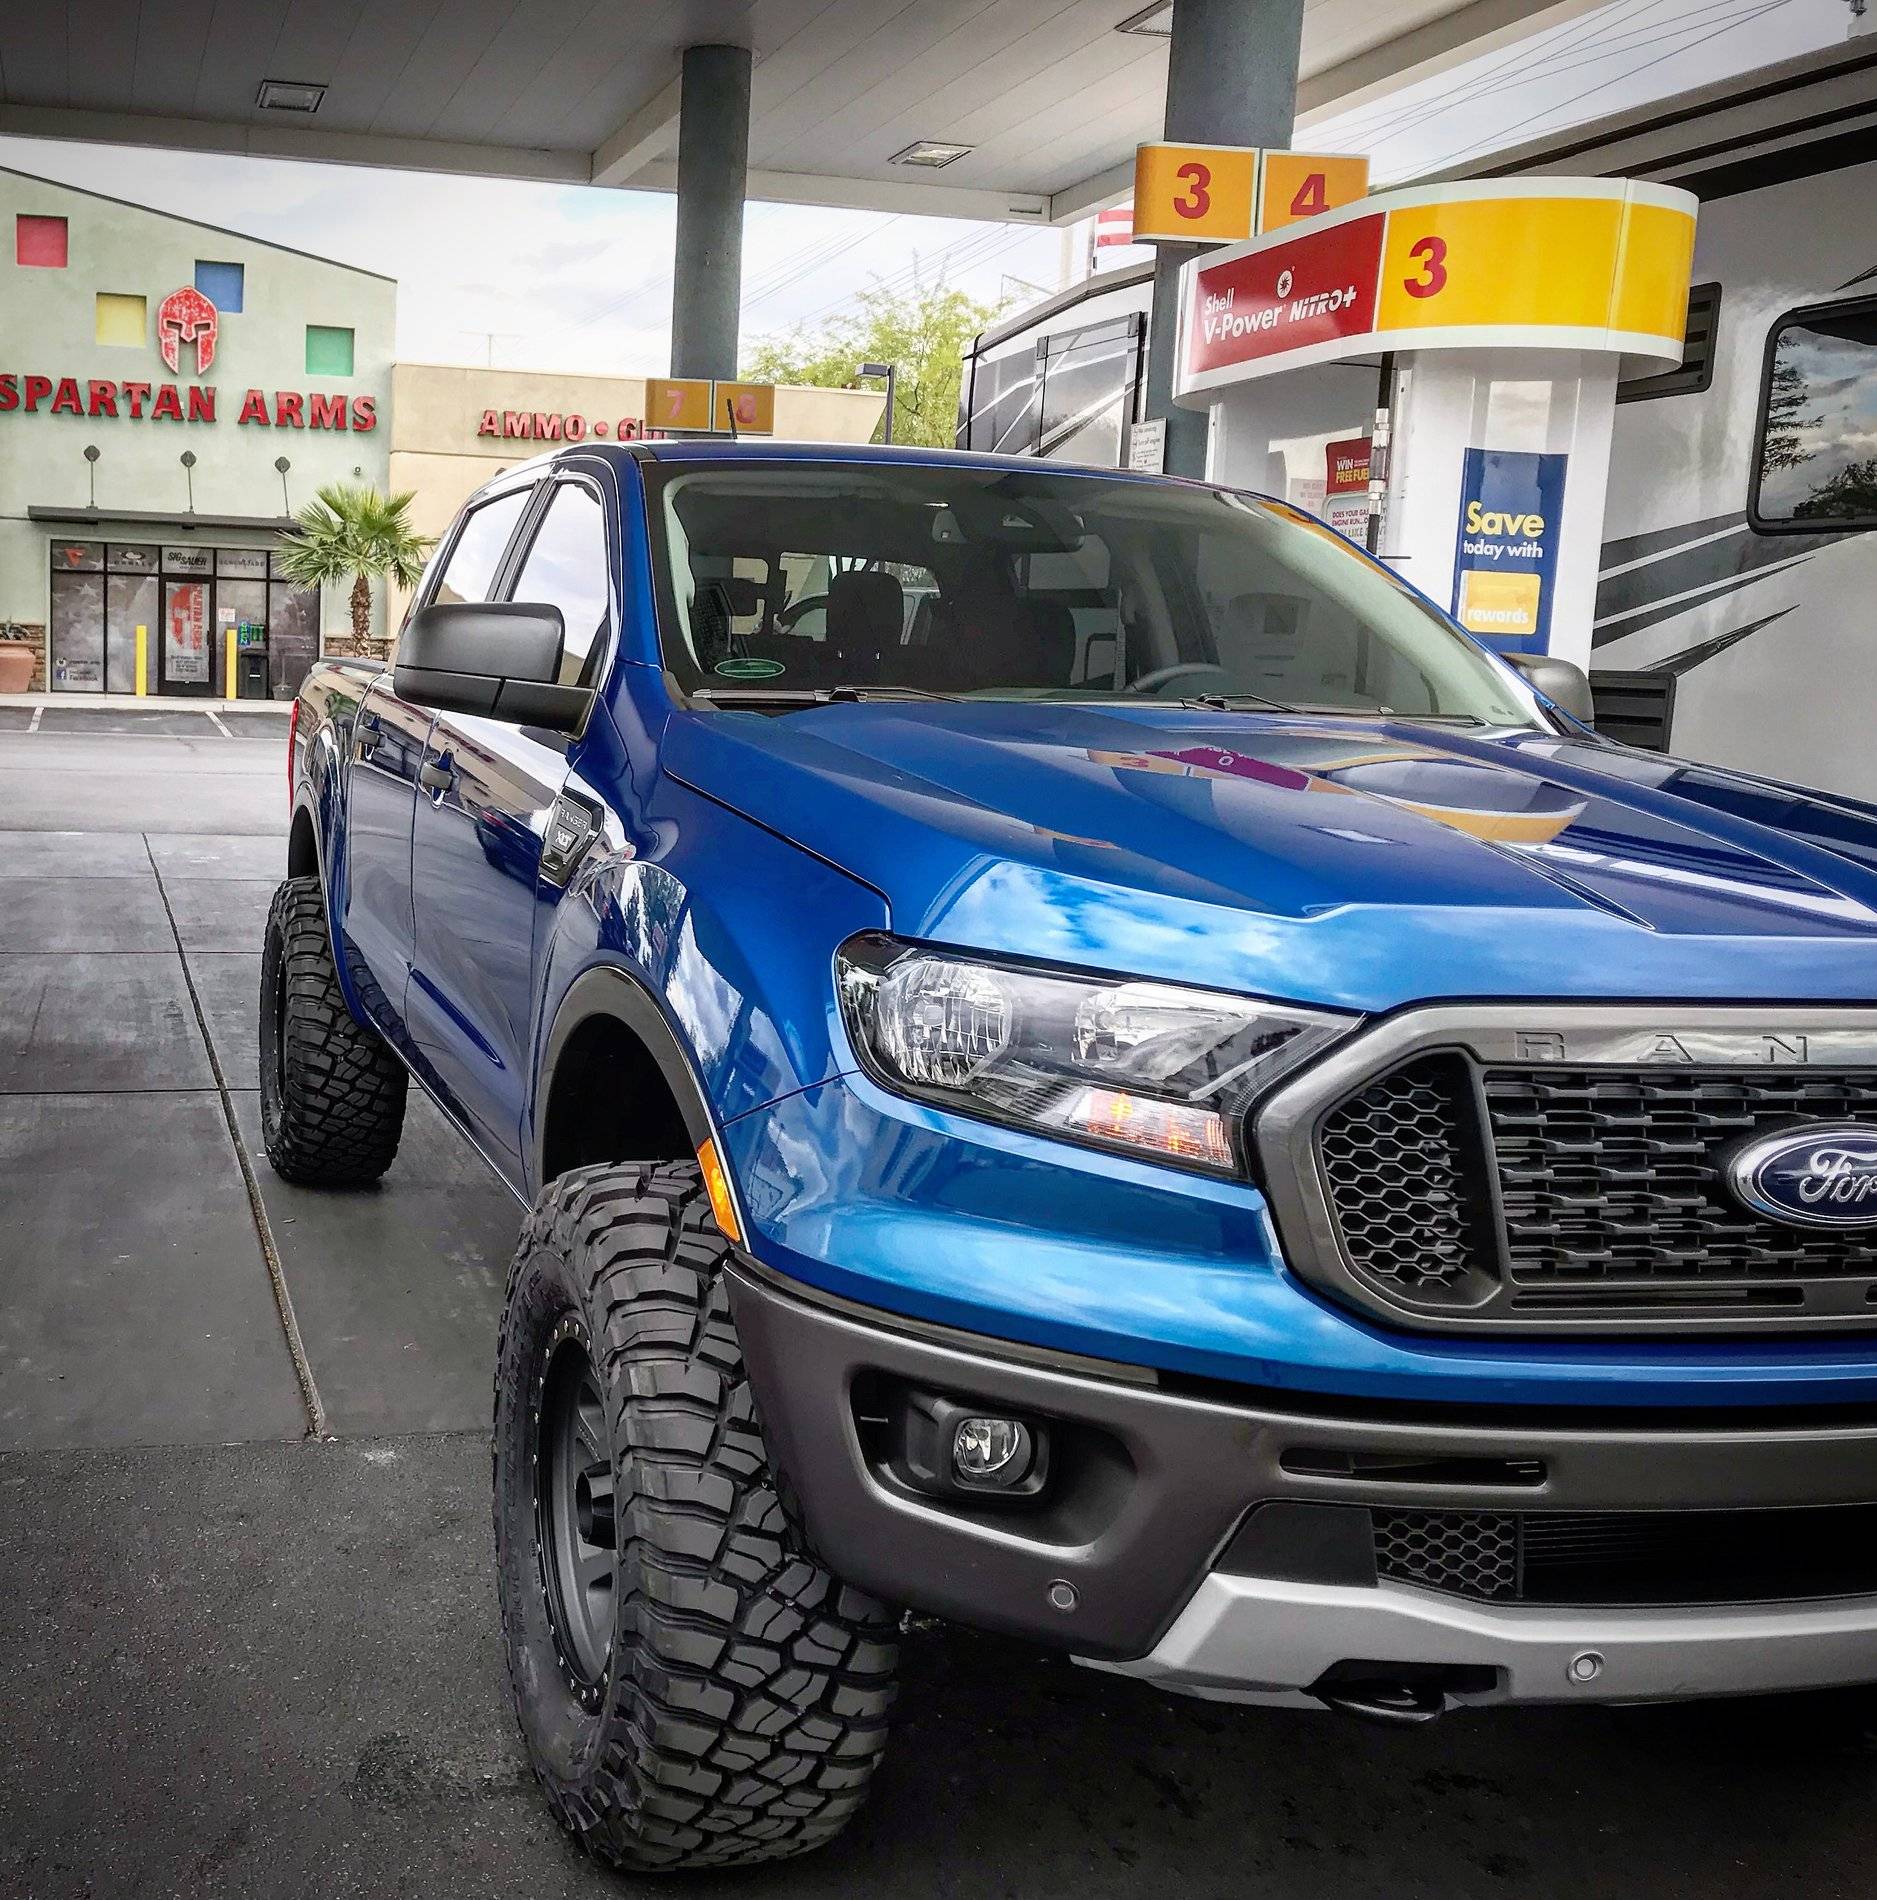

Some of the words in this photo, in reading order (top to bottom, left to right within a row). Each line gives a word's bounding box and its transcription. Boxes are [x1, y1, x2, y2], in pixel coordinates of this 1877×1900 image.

[1174, 163, 1211, 219] 3
[1290, 173, 1331, 216] 4
[1404, 236, 1447, 298] 3
[1204, 287, 1235, 315] Shell
[1203, 307, 1284, 345] V-Power
[0, 374, 217, 423] SPARTAN
[238, 389, 377, 433] ARMS
[666, 389, 688, 418] 7
[477, 410, 586, 441] AMMO
[1336, 471, 1353, 483] FREE
[1337, 459, 1353, 471] WIN
[1465, 500, 1545, 538] Save
[1463, 538, 1505, 560] today
[1507, 542, 1545, 558] with
[1467, 608, 1530, 624] rewards
